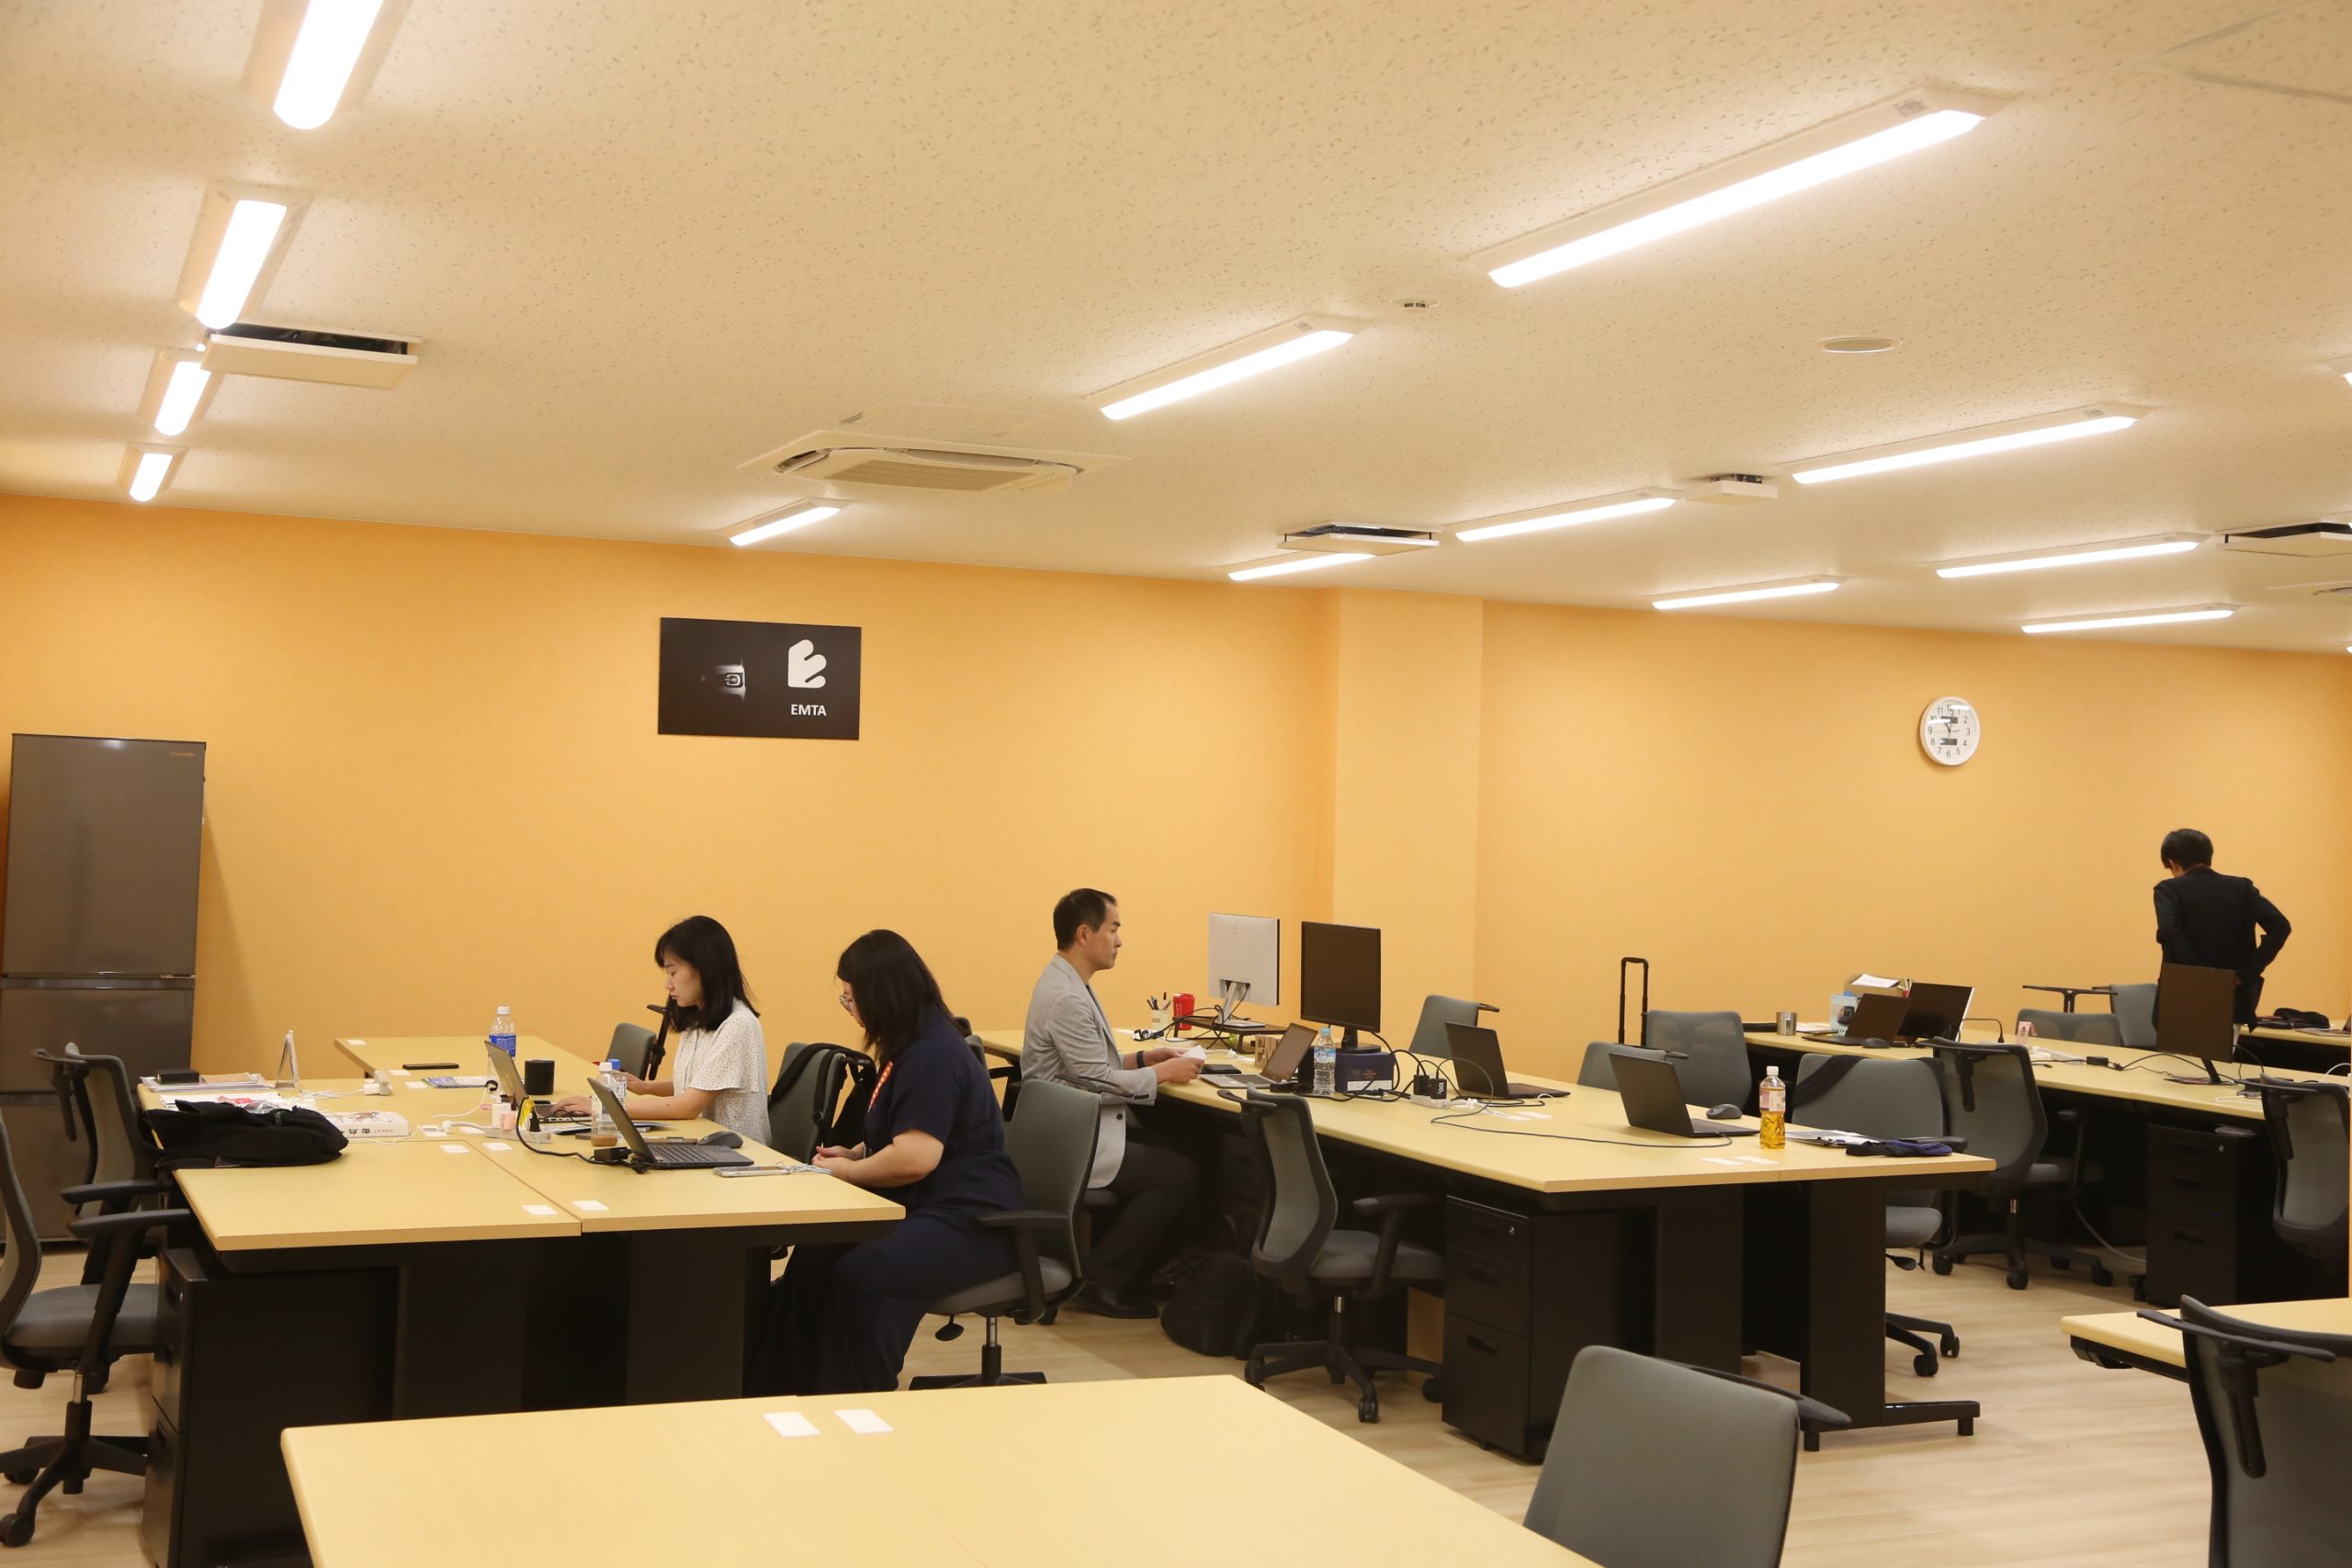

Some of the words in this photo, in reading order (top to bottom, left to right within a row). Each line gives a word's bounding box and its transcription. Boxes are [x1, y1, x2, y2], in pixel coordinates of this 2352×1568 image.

[791, 704, 827, 716] EMTA
[1928, 726, 1932, 734] 9
[1965, 728, 1971, 736] 3
[1930, 738, 1935, 746] 8
[1937, 747, 1942, 755] 7
[1946, 750, 1951, 758] 6
[1956, 747, 1961, 755] 5
